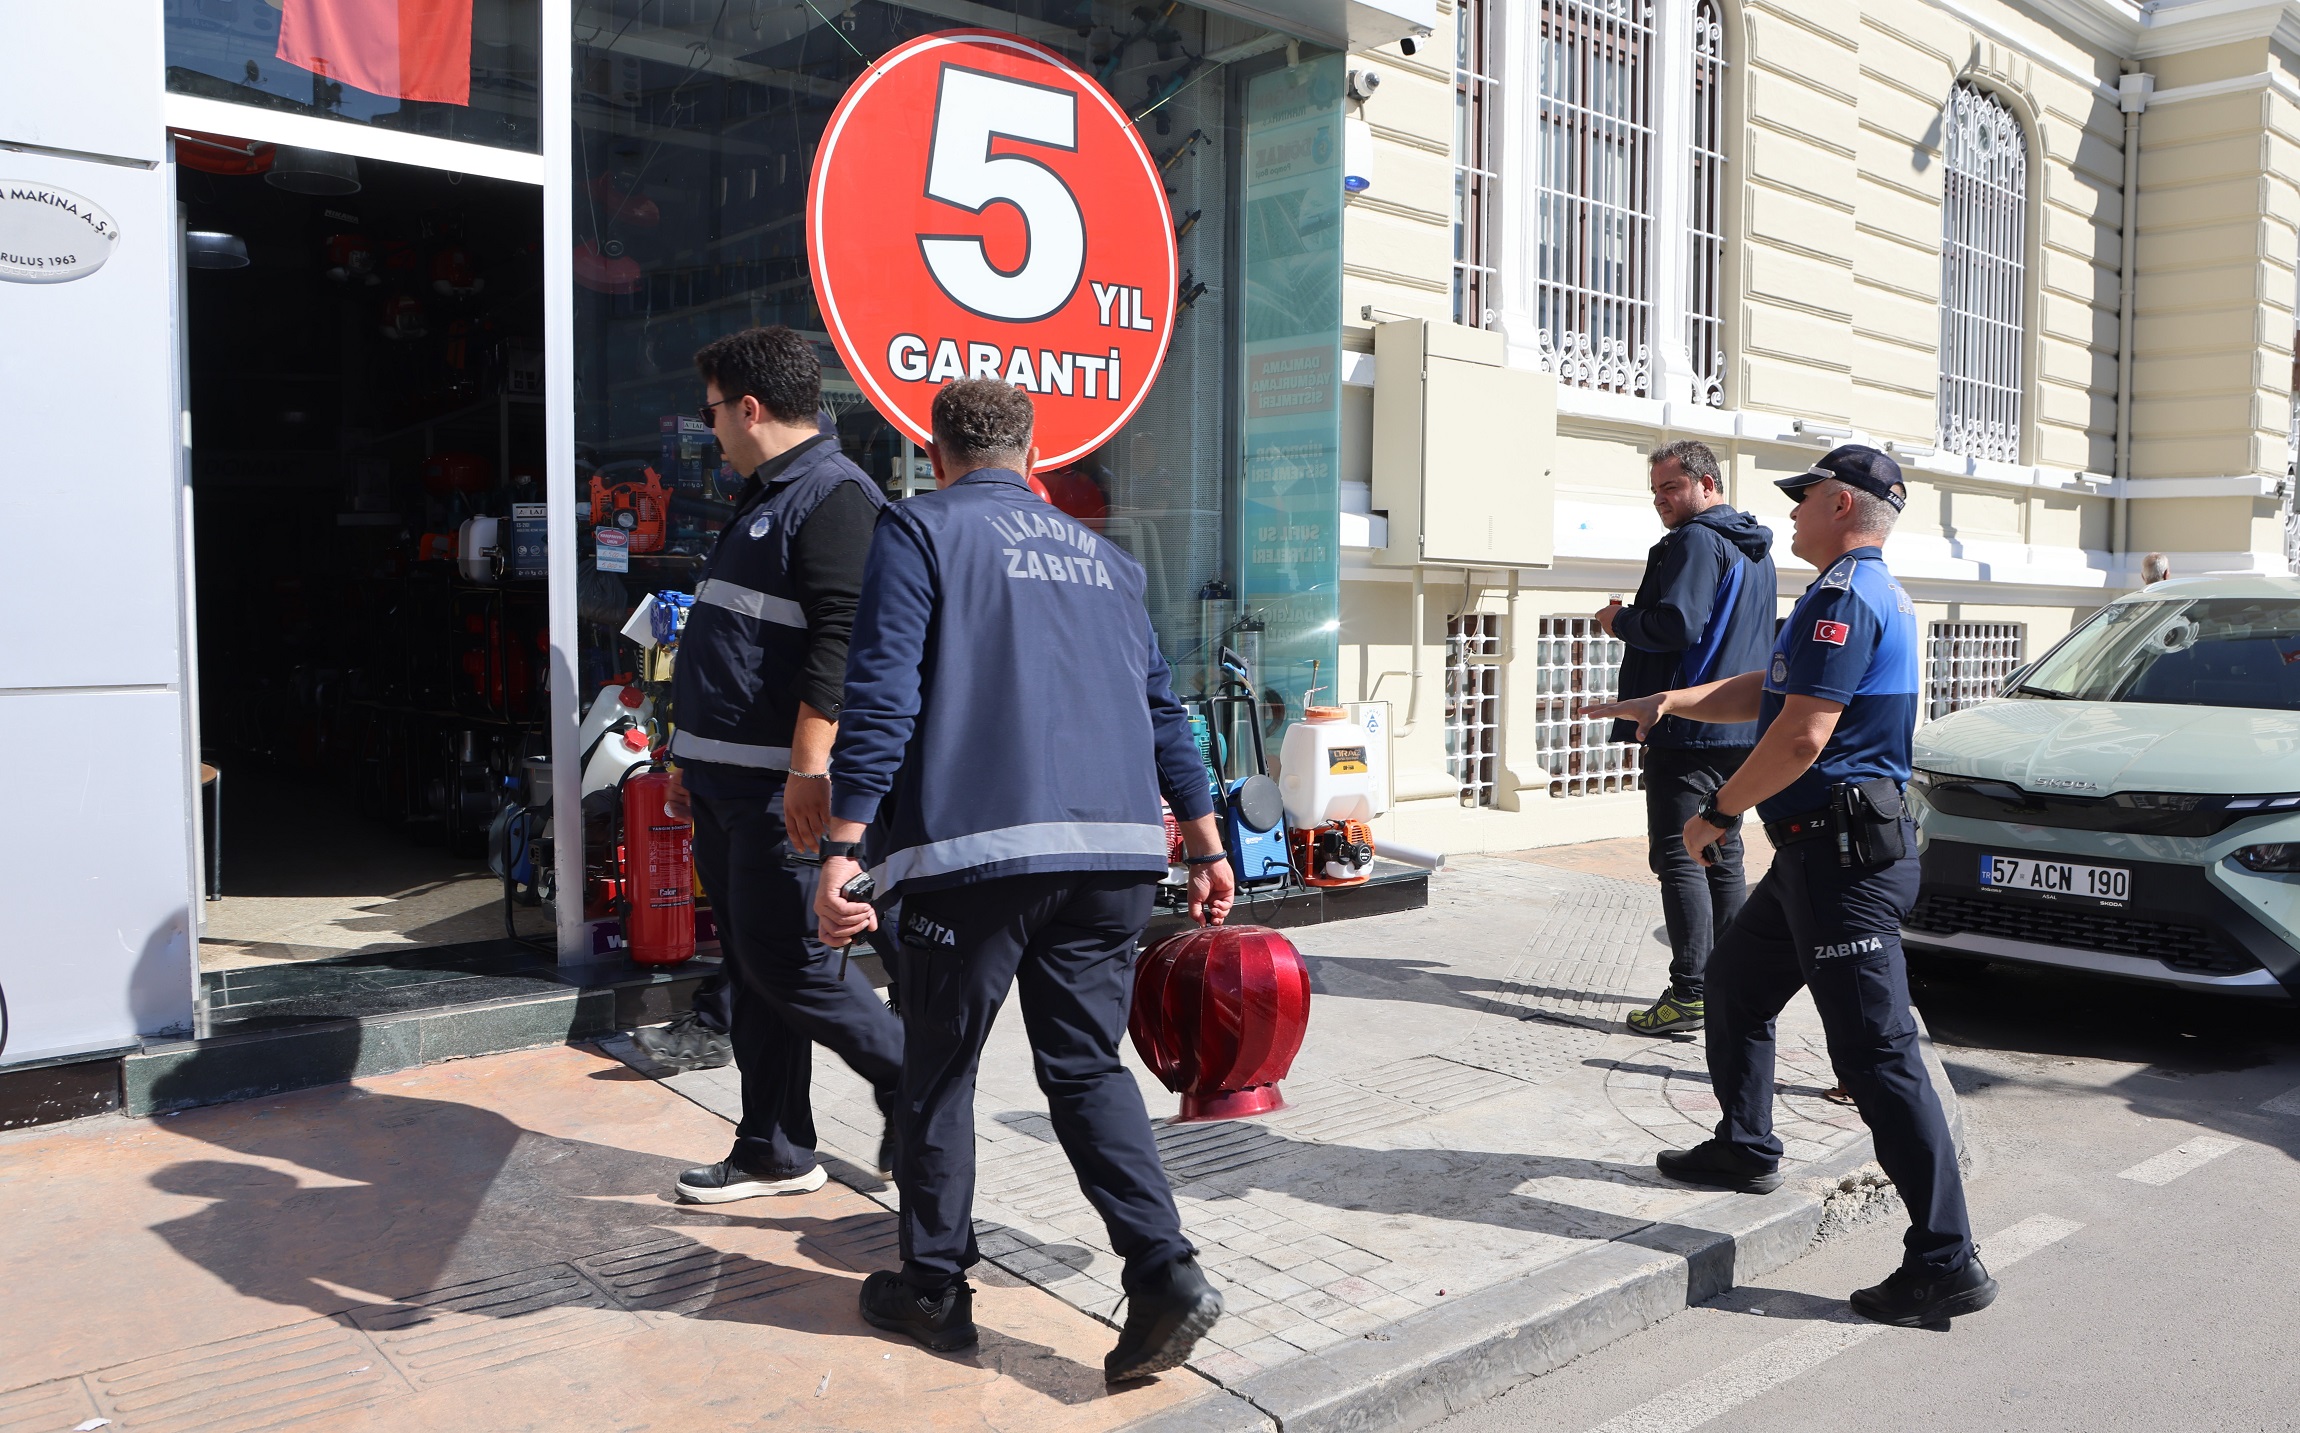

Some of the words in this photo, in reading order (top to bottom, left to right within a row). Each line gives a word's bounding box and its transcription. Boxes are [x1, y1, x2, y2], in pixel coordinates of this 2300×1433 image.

[11, 188, 77, 215] MAKİNA
[81, 212, 107, 236] A.Ş.
[915, 61, 1087, 323] 5
[1090, 279, 1154, 332] YIL
[49, 255, 76, 266] 1963
[886, 333, 1121, 401] GARANTİ
[984, 510, 1097, 558] İLKADIM
[1002, 548, 1115, 590] ZABITA
[1981, 871, 1991, 880] TR
[1993, 858, 2019, 884] 57
[2030, 863, 2072, 892] ACN
[2088, 869, 2126, 897] 190
[907, 912, 956, 946] ABITA
[1814, 936, 1883, 959] ZABITA
